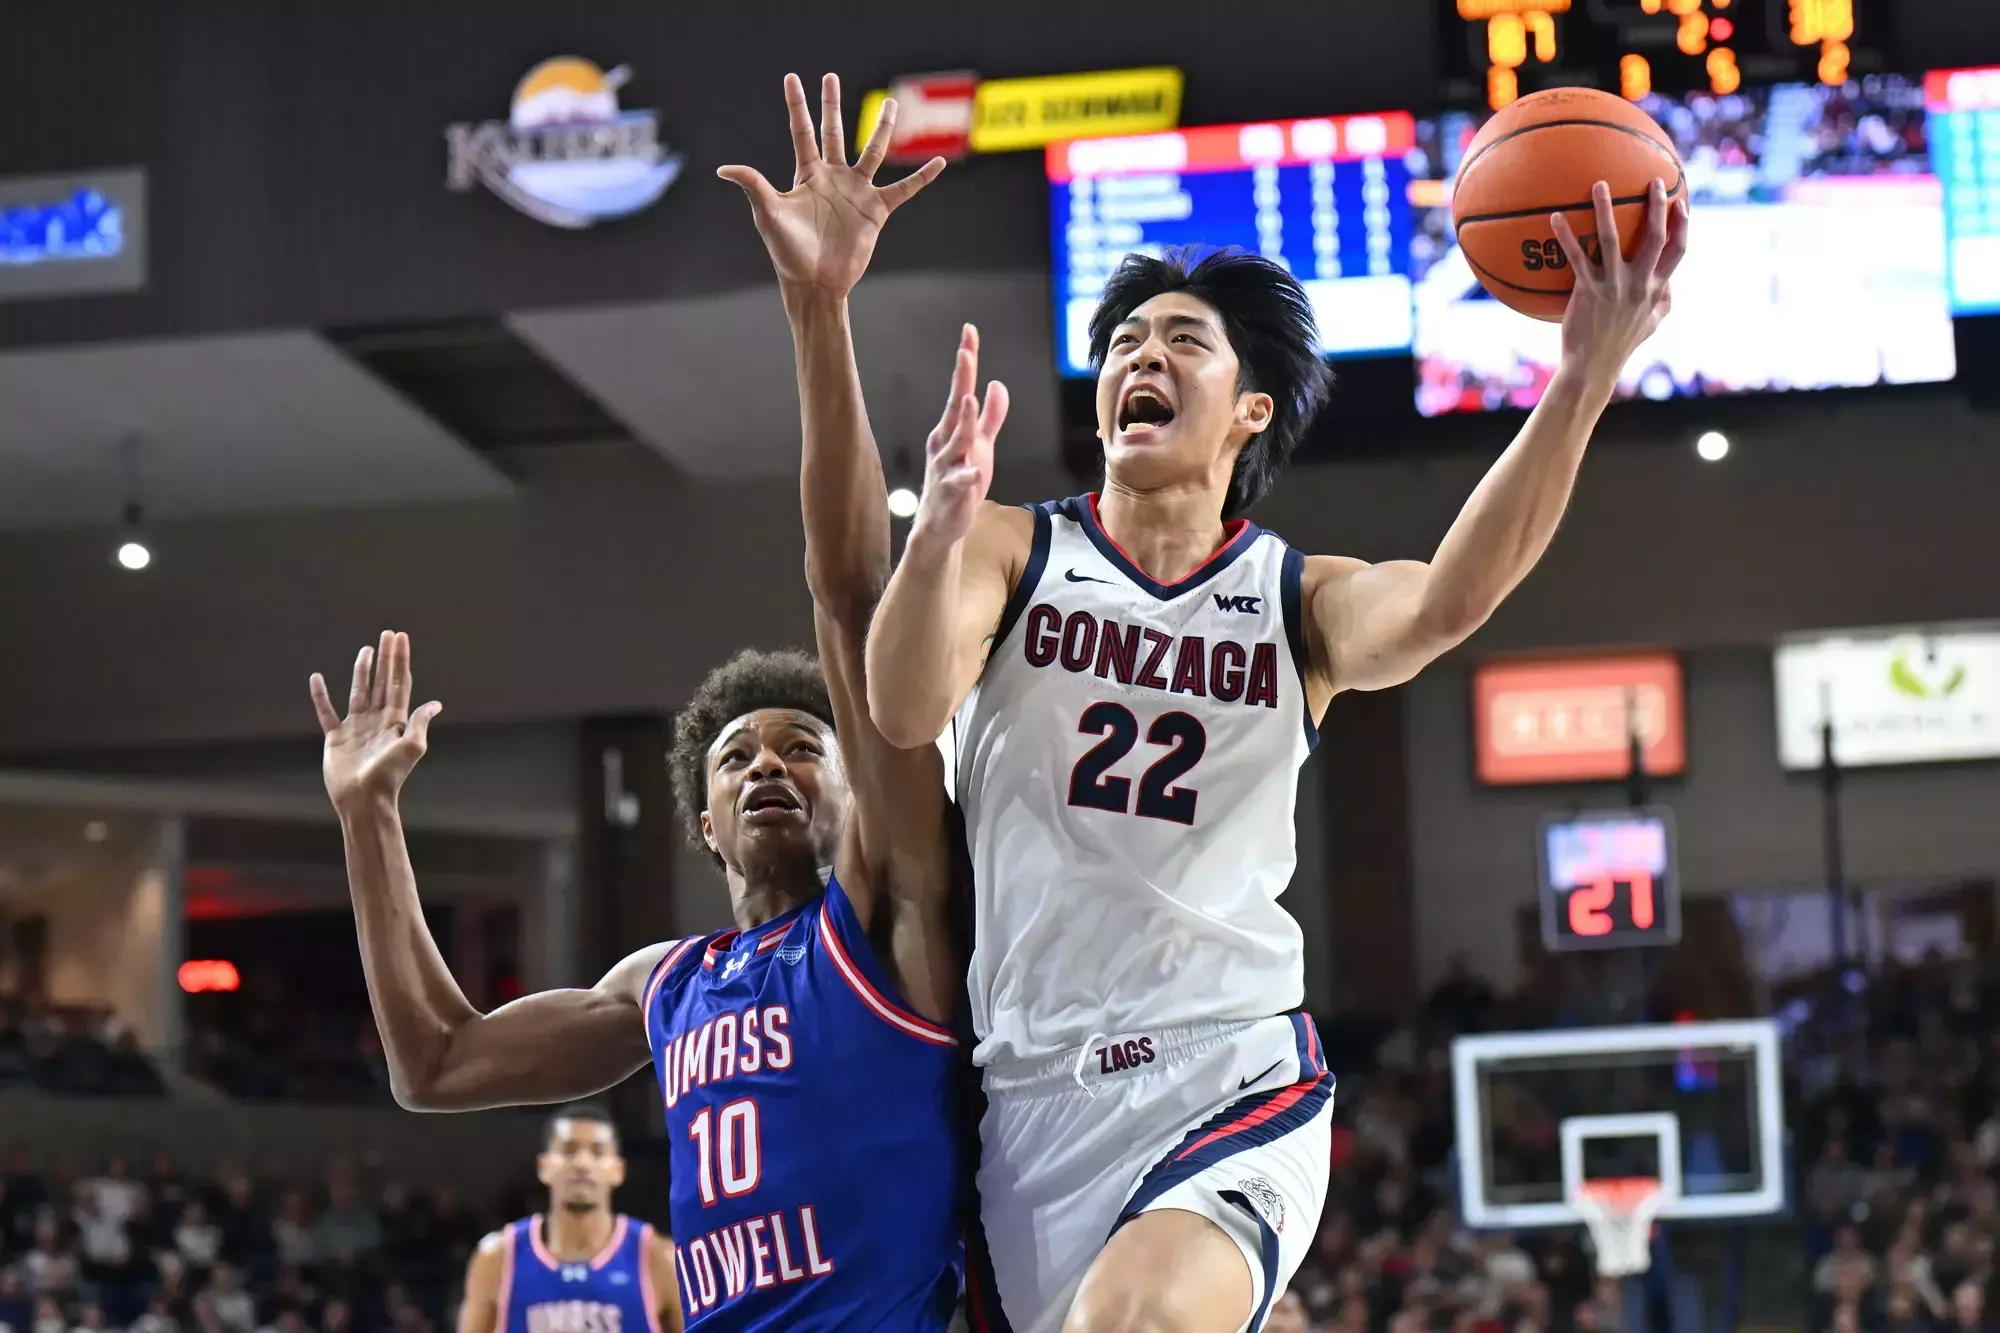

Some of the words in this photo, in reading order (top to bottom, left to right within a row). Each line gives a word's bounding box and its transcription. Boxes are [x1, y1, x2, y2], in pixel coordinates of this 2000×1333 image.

[1024, 603, 1278, 709] GONZAGA
[1213, 594, 1262, 614] WCC
[1067, 701, 1206, 826] 22
[664, 1004, 793, 1109] UMASS
[1095, 1036, 1156, 1074] ZAGS
[688, 1097, 761, 1208] 10
[676, 1204, 833, 1316] LOWELL
